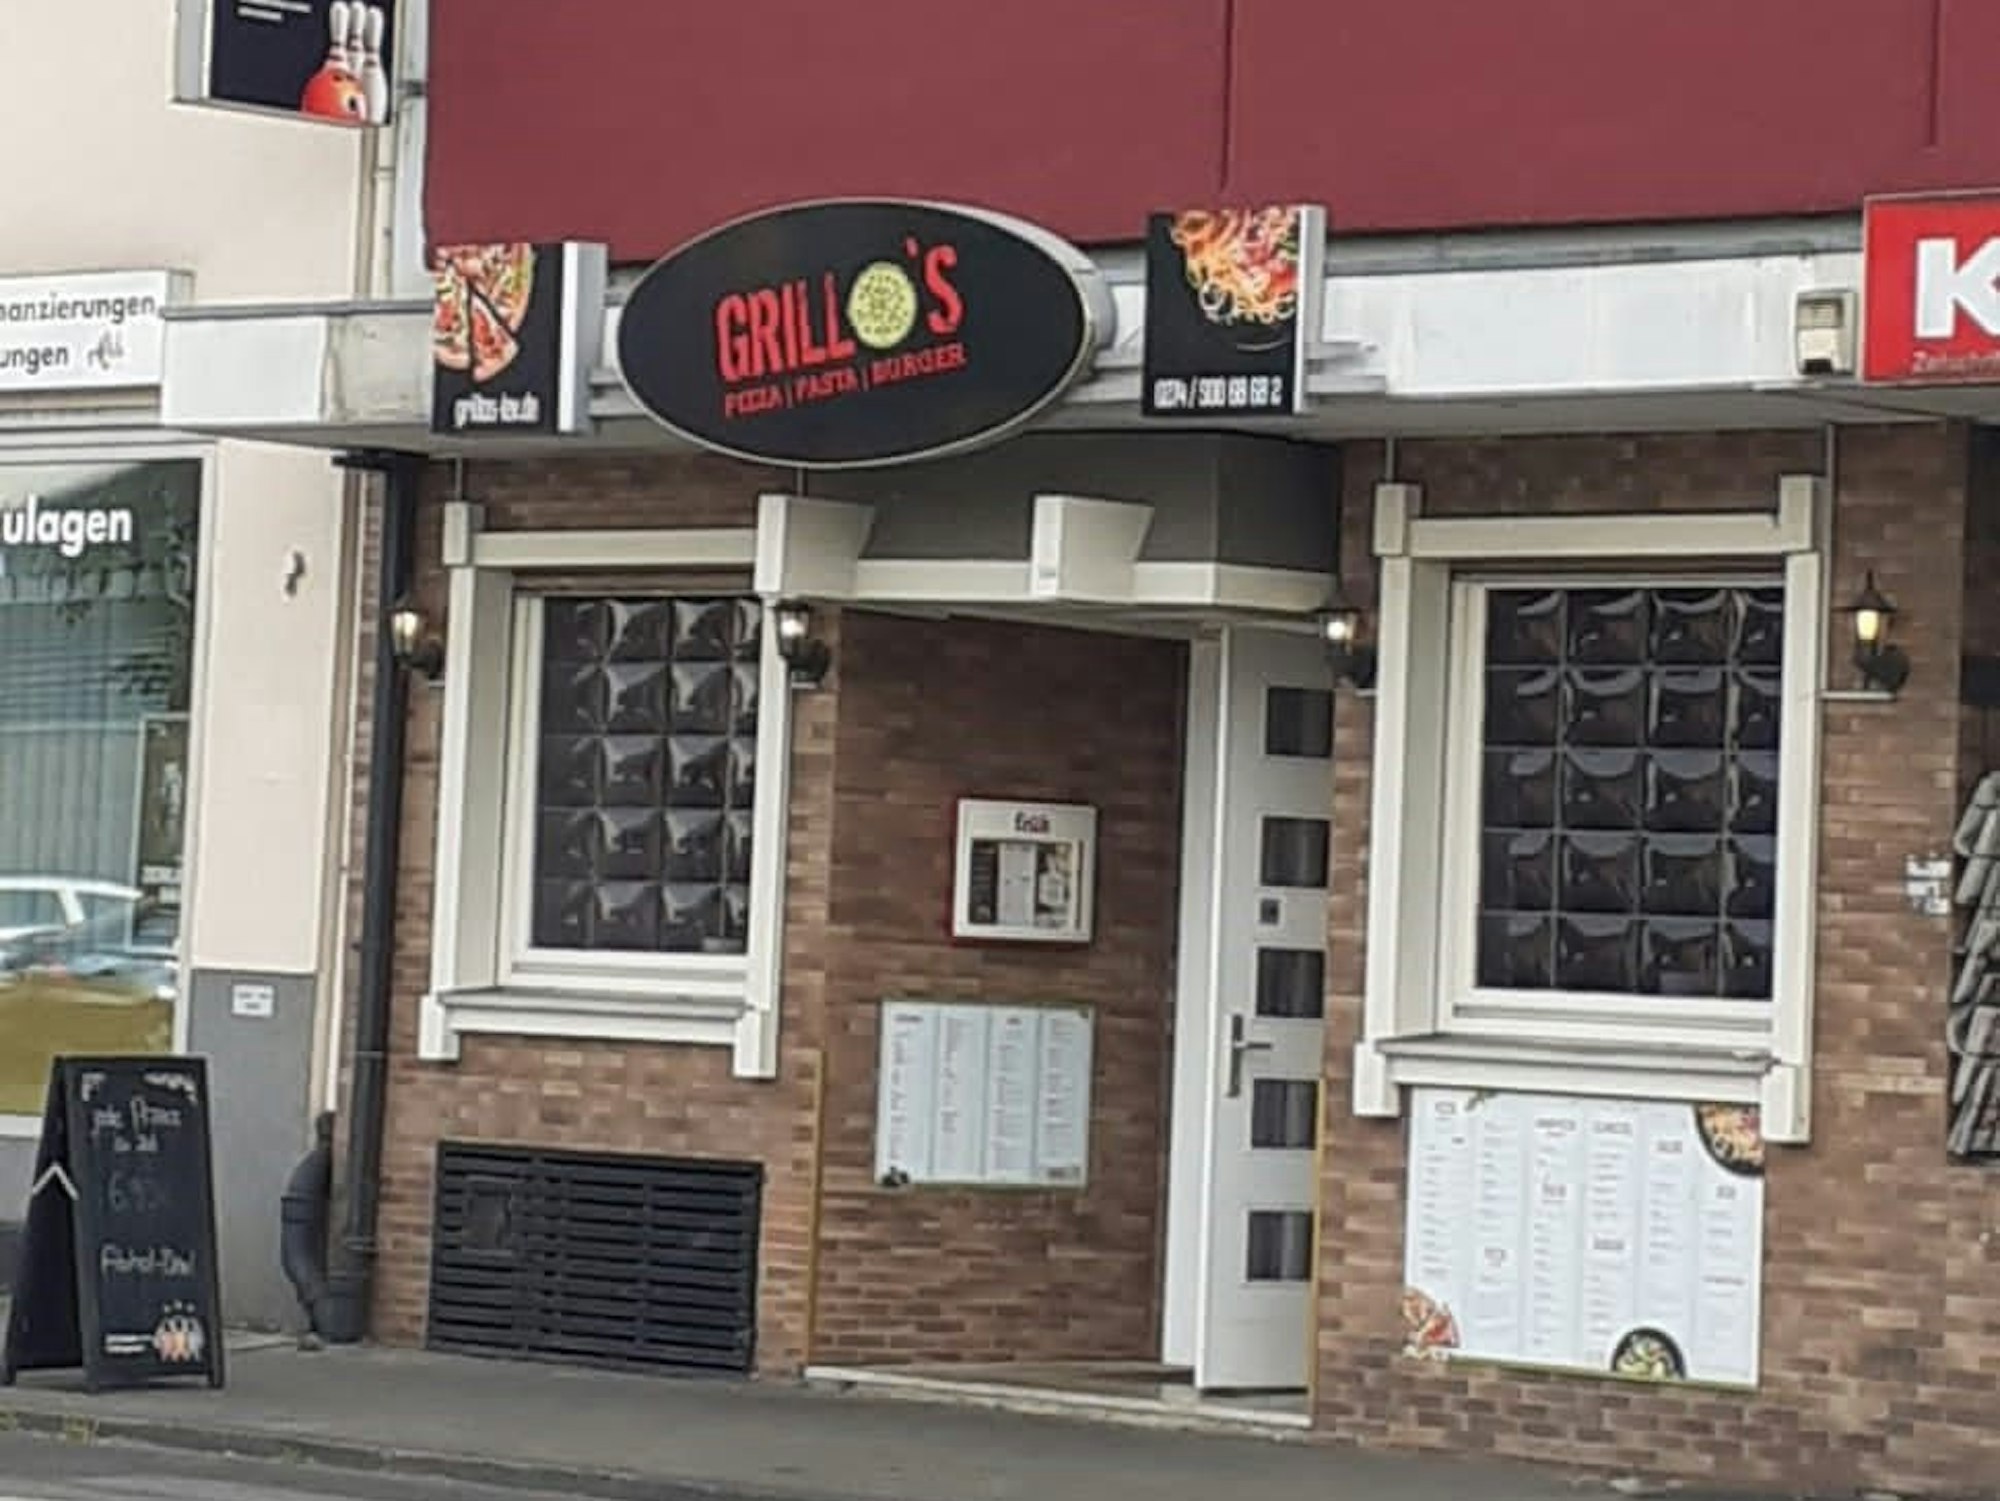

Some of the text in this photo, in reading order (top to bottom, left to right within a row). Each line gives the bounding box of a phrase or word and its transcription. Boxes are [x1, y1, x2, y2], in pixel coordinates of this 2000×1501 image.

[717, 237, 964, 382] GRILLO'S
[725, 385, 783, 418] PIZZA
[795, 366, 859, 402] PASTA
[871, 342, 967, 384] BURGER
